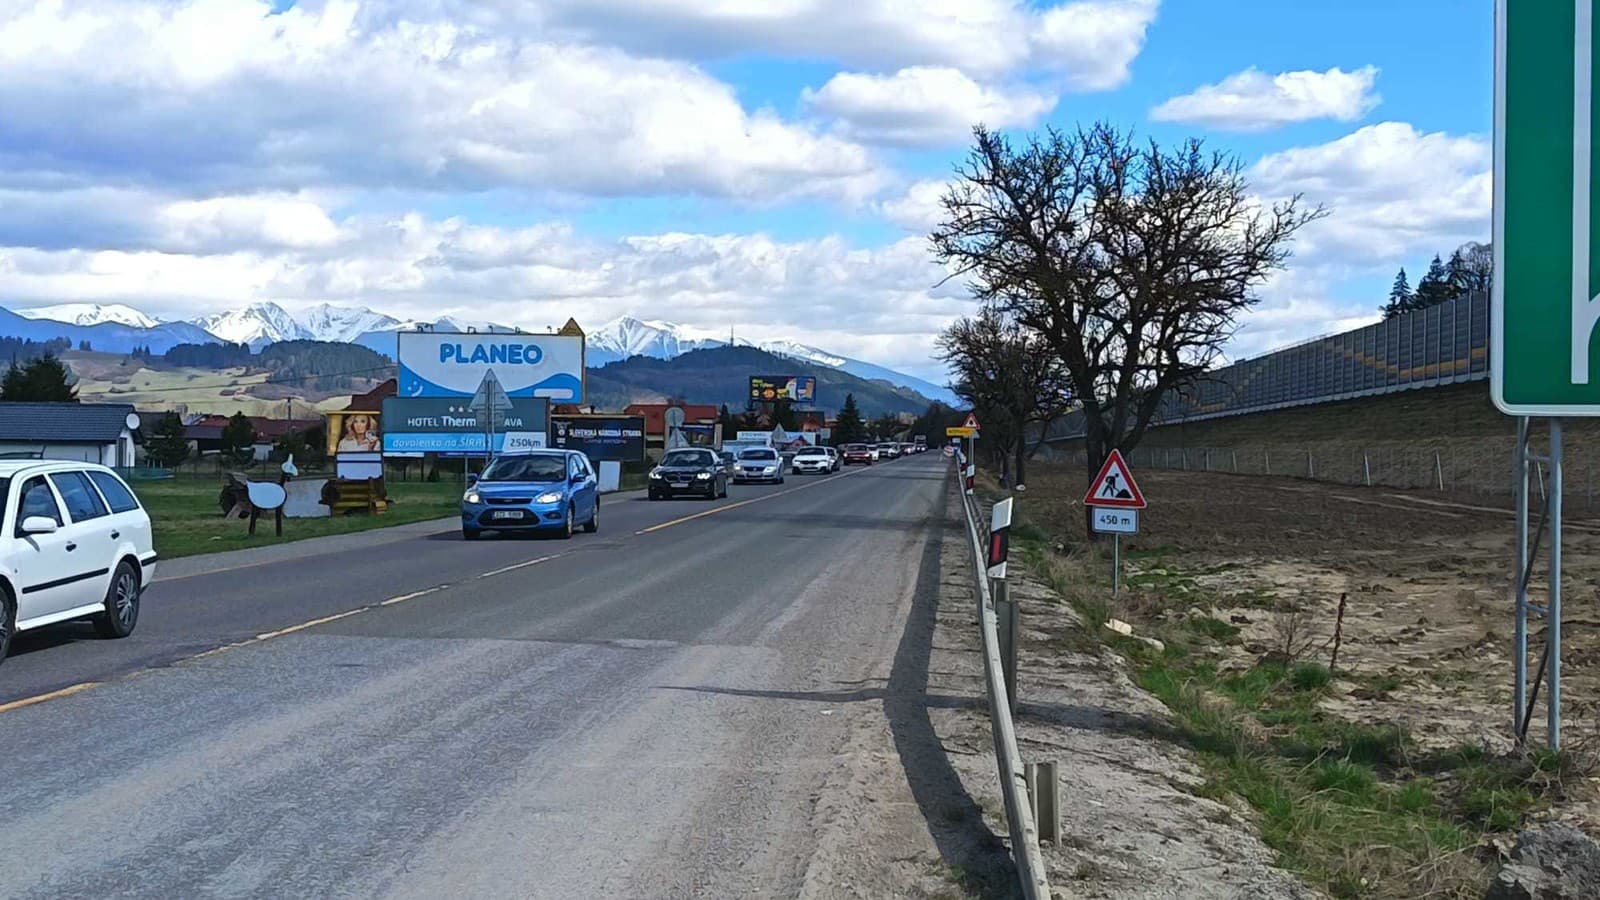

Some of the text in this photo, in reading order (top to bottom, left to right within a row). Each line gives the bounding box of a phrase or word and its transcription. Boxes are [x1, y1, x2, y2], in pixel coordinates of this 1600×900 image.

[440, 343, 543, 364] PLANEO
[407, 415, 524, 427] HOTEL Therm AVA
[510, 438, 541, 448] 250km
[1099, 514, 1130, 526] 450 m
